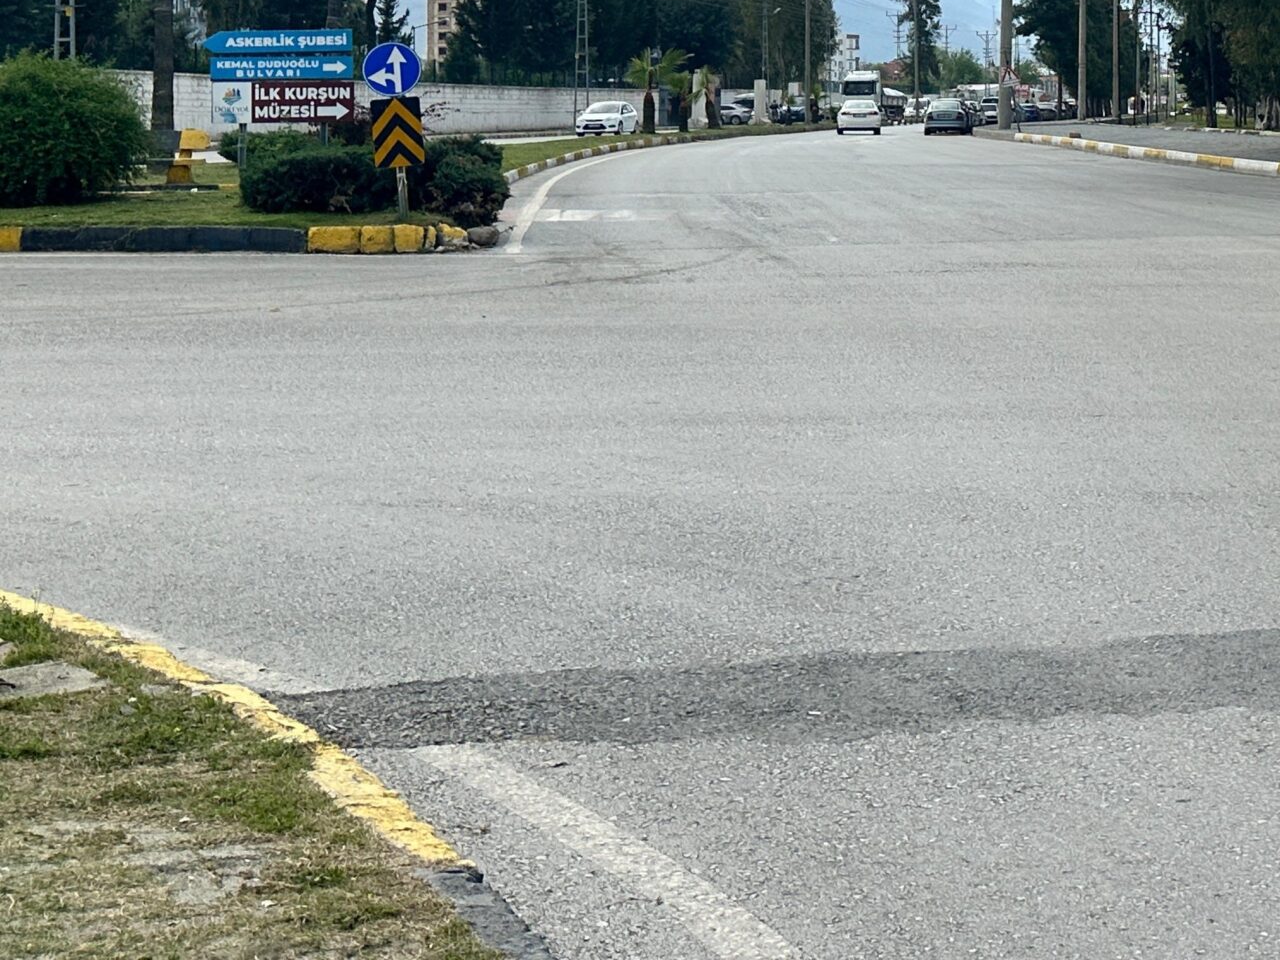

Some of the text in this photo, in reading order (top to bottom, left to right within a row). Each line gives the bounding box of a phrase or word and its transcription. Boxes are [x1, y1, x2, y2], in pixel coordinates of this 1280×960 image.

[225, 32, 347, 48] ASKERLİK ŞUBESİ
[216, 58, 319, 69] KEMAL DUDUOĞLU
[236, 69, 300, 77] BULVARI
[255, 83, 351, 103] İLK KURŞUN
[254, 101, 315, 119] MÜZESİ
